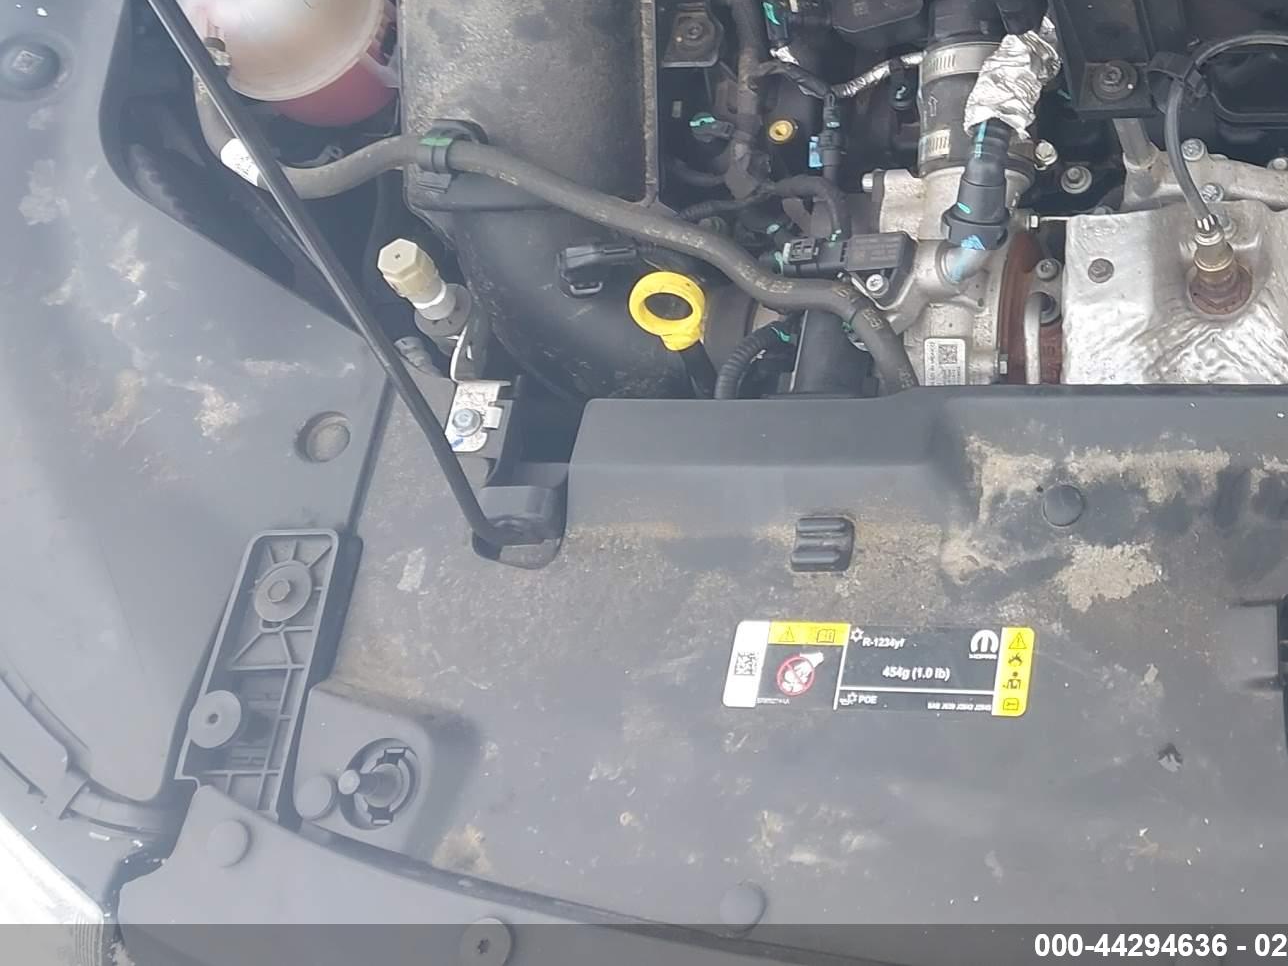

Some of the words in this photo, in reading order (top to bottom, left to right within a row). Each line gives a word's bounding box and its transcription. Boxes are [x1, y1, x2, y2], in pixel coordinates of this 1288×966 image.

[862, 637, 905, 650] R-1234yf
[882, 665, 911, 681] 454g
[911, 666, 934, 681] (1.0
[934, 667, 951, 682] lb)
[858, 694, 878, 705] POE
